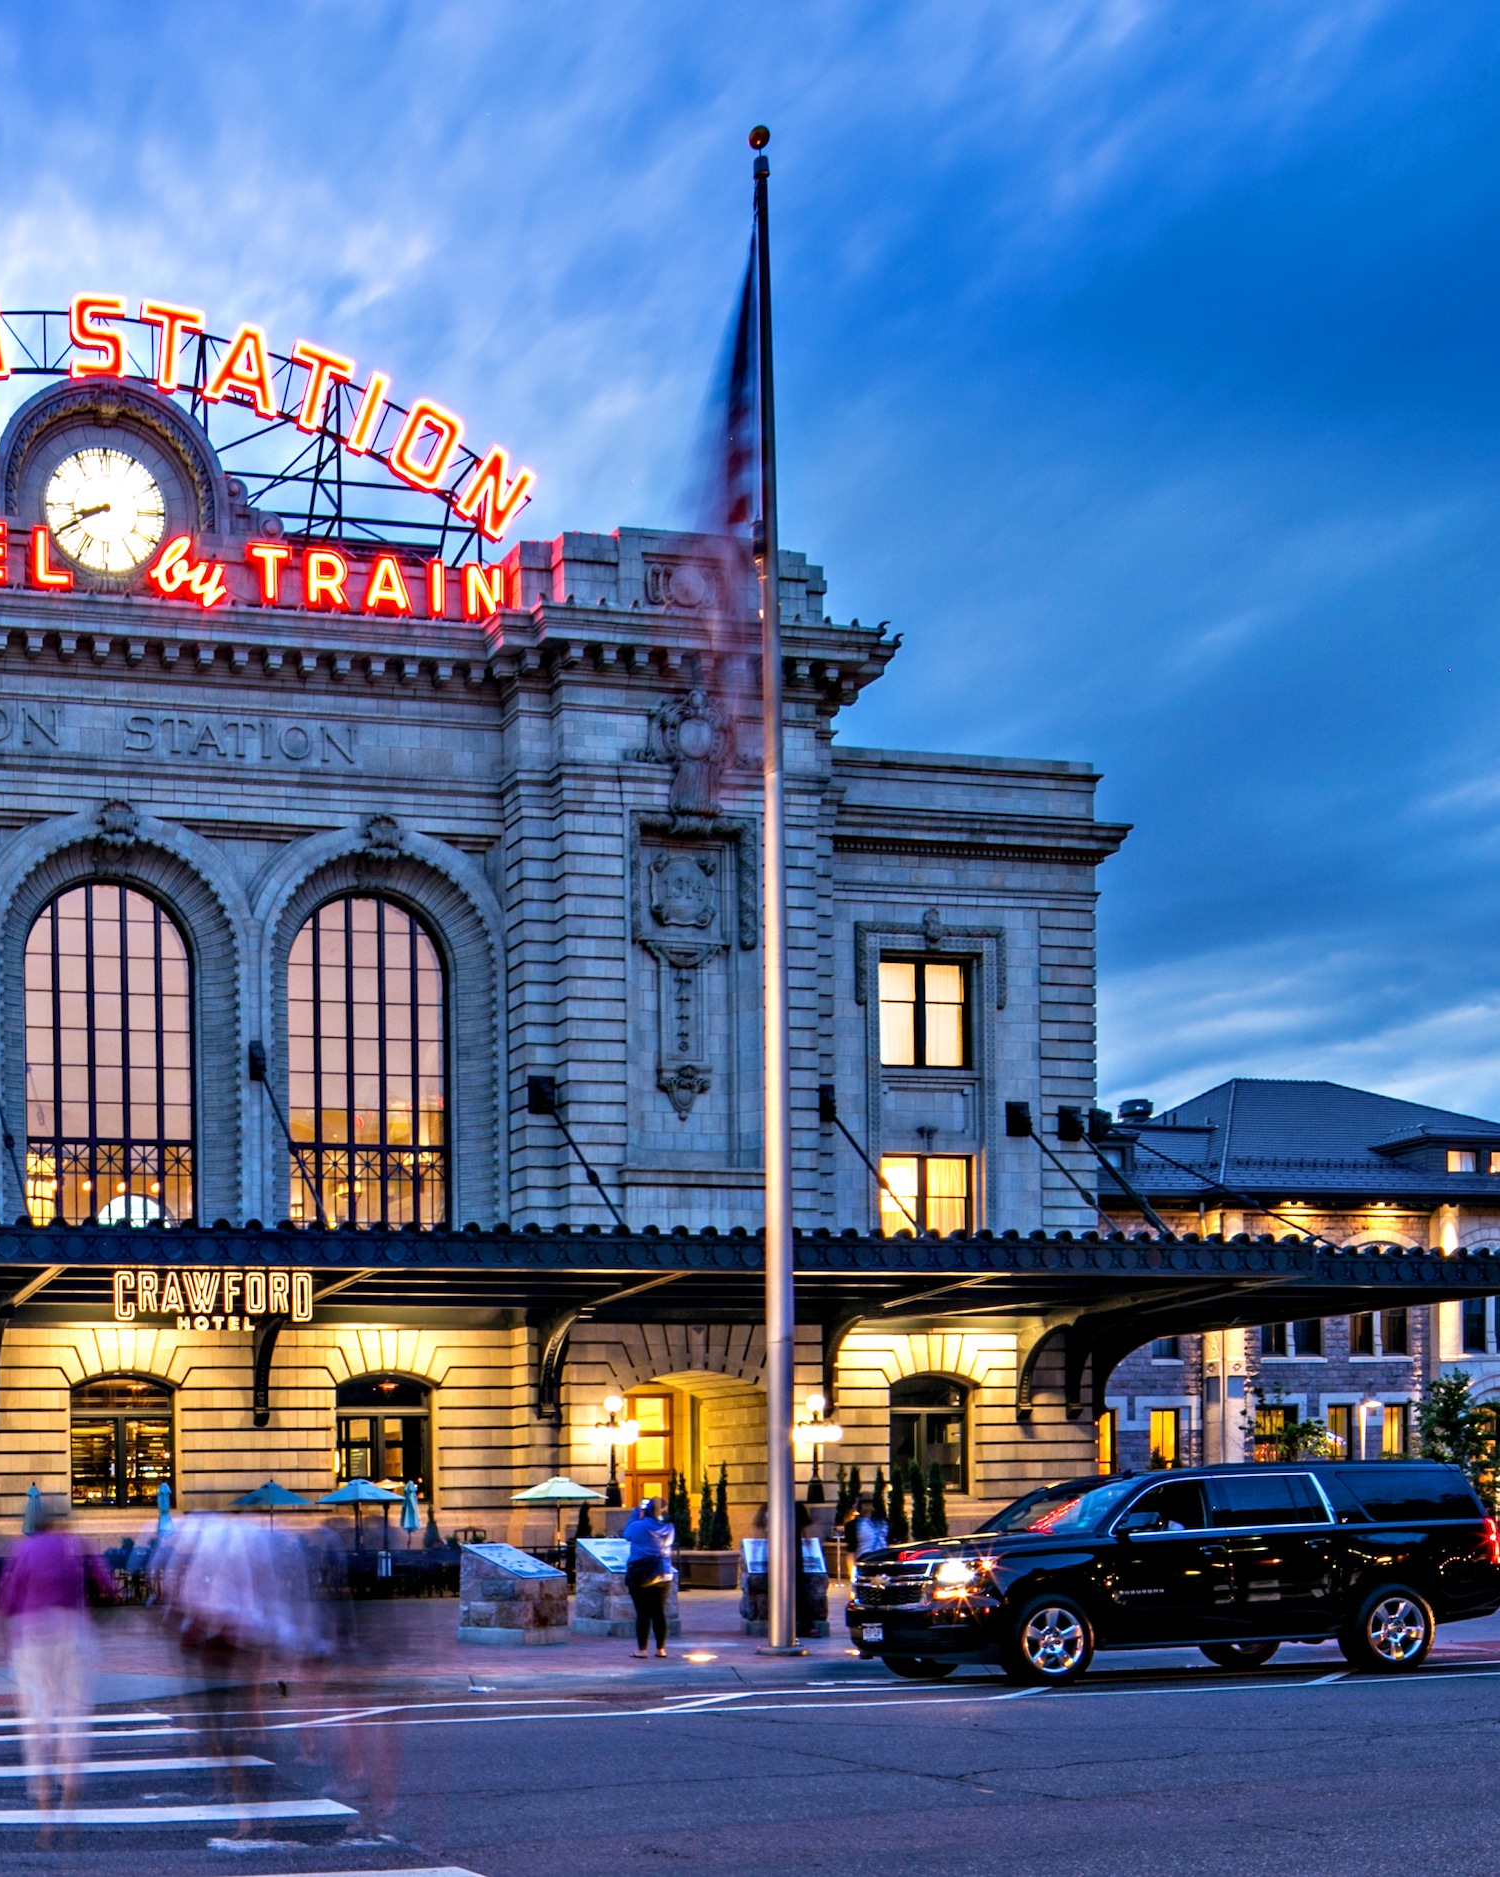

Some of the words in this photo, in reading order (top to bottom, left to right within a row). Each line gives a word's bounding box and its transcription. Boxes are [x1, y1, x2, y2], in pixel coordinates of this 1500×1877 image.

[68, 291, 537, 542] STATION
[149, 535, 228, 609] by
[245, 541, 505, 619] TRAIN
[123, 716, 358, 765] STATION
[663, 877, 706, 902] 1914
[113, 1270, 314, 1323] CRAWFORD
[176, 1315, 256, 1332] HOTEL
